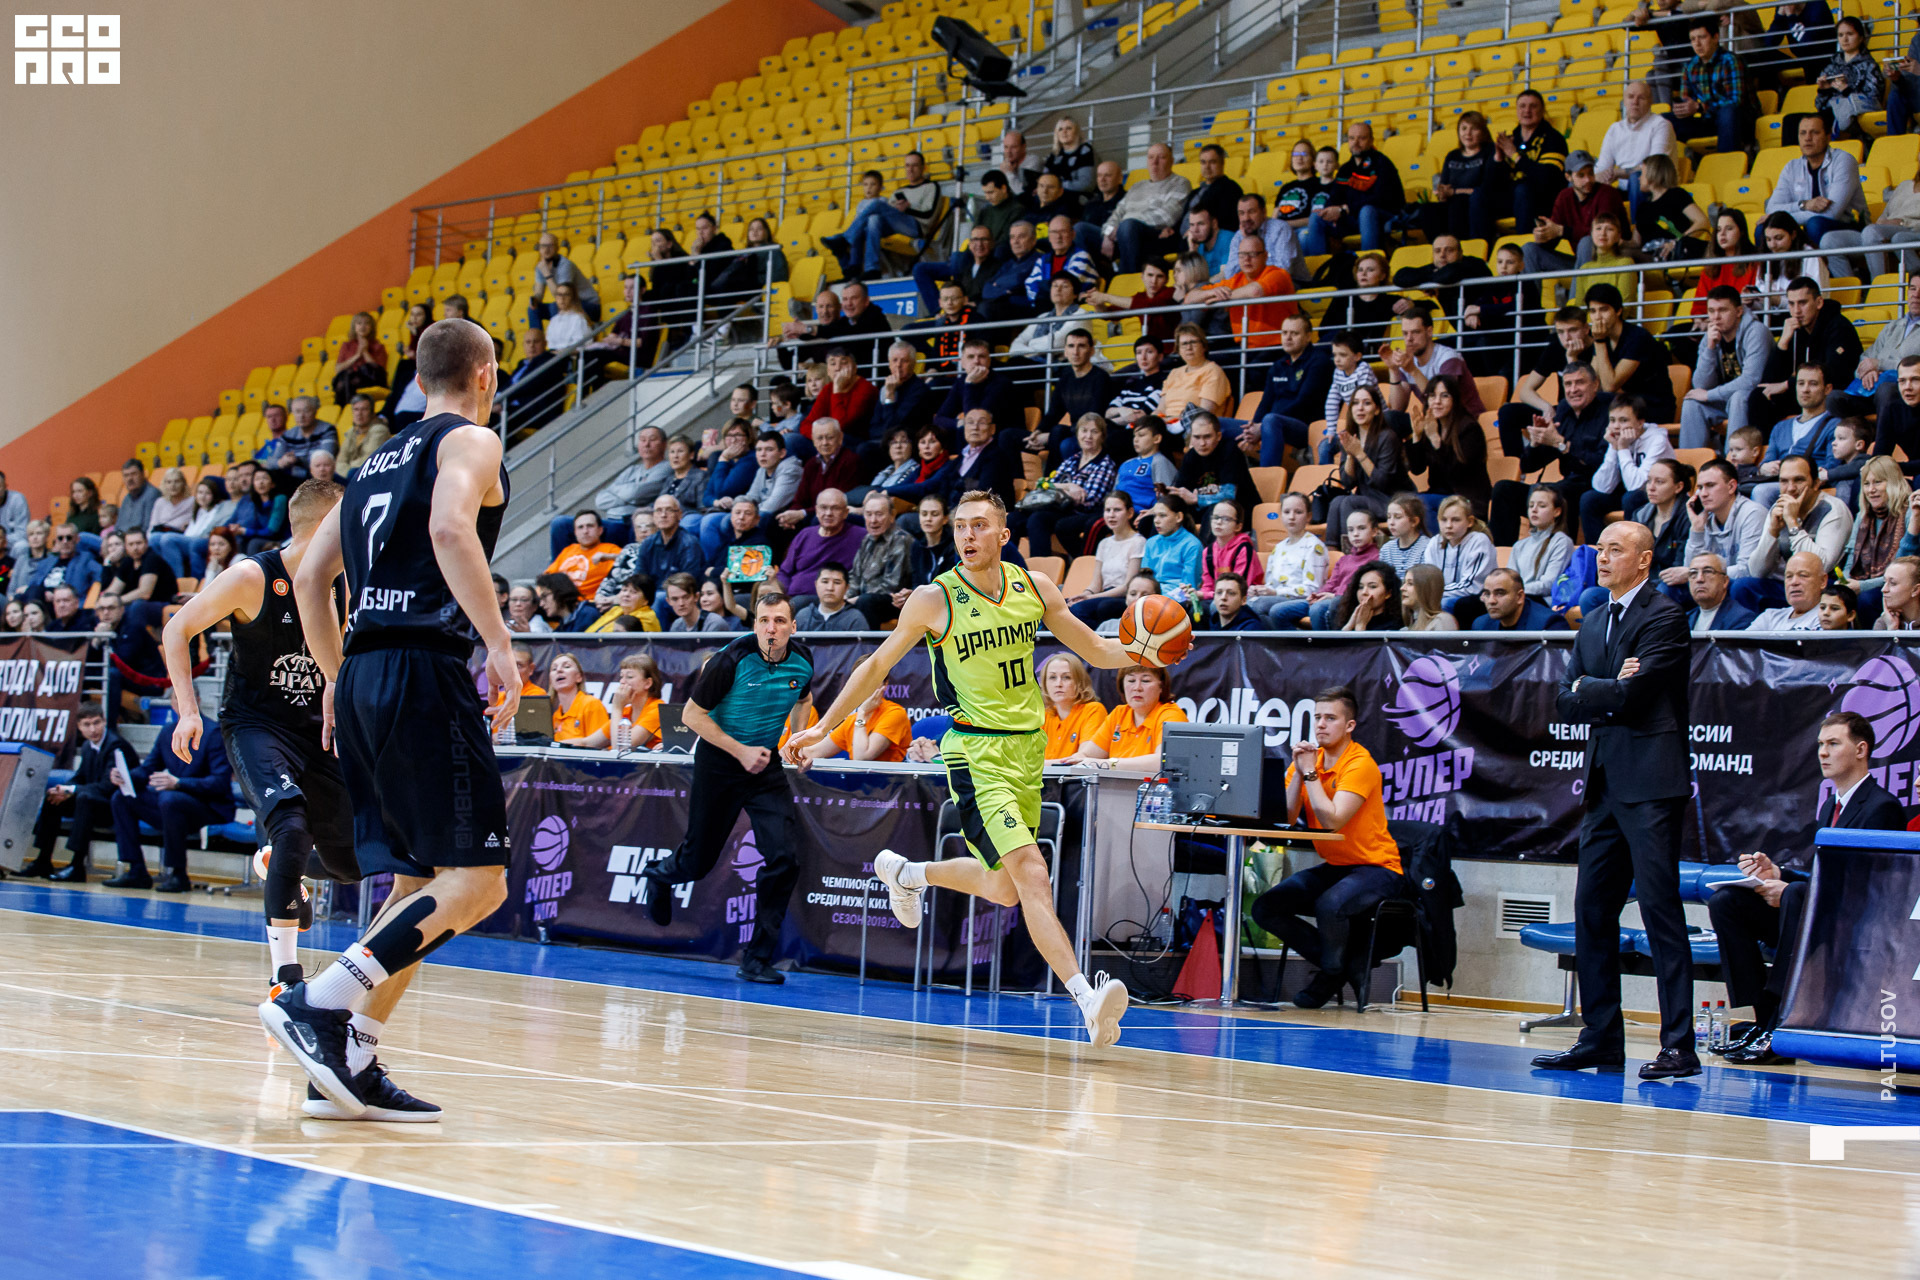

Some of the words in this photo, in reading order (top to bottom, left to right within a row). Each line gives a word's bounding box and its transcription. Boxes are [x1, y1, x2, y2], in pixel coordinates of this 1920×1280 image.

[37, 660, 82, 698] ДЛЯ
[998, 657, 1027, 691] 10
[1378, 746, 1475, 804] СУПЕР
[1529, 750, 1585, 771] СРЕДИ
[807, 892, 840, 907] СРЕДИ
